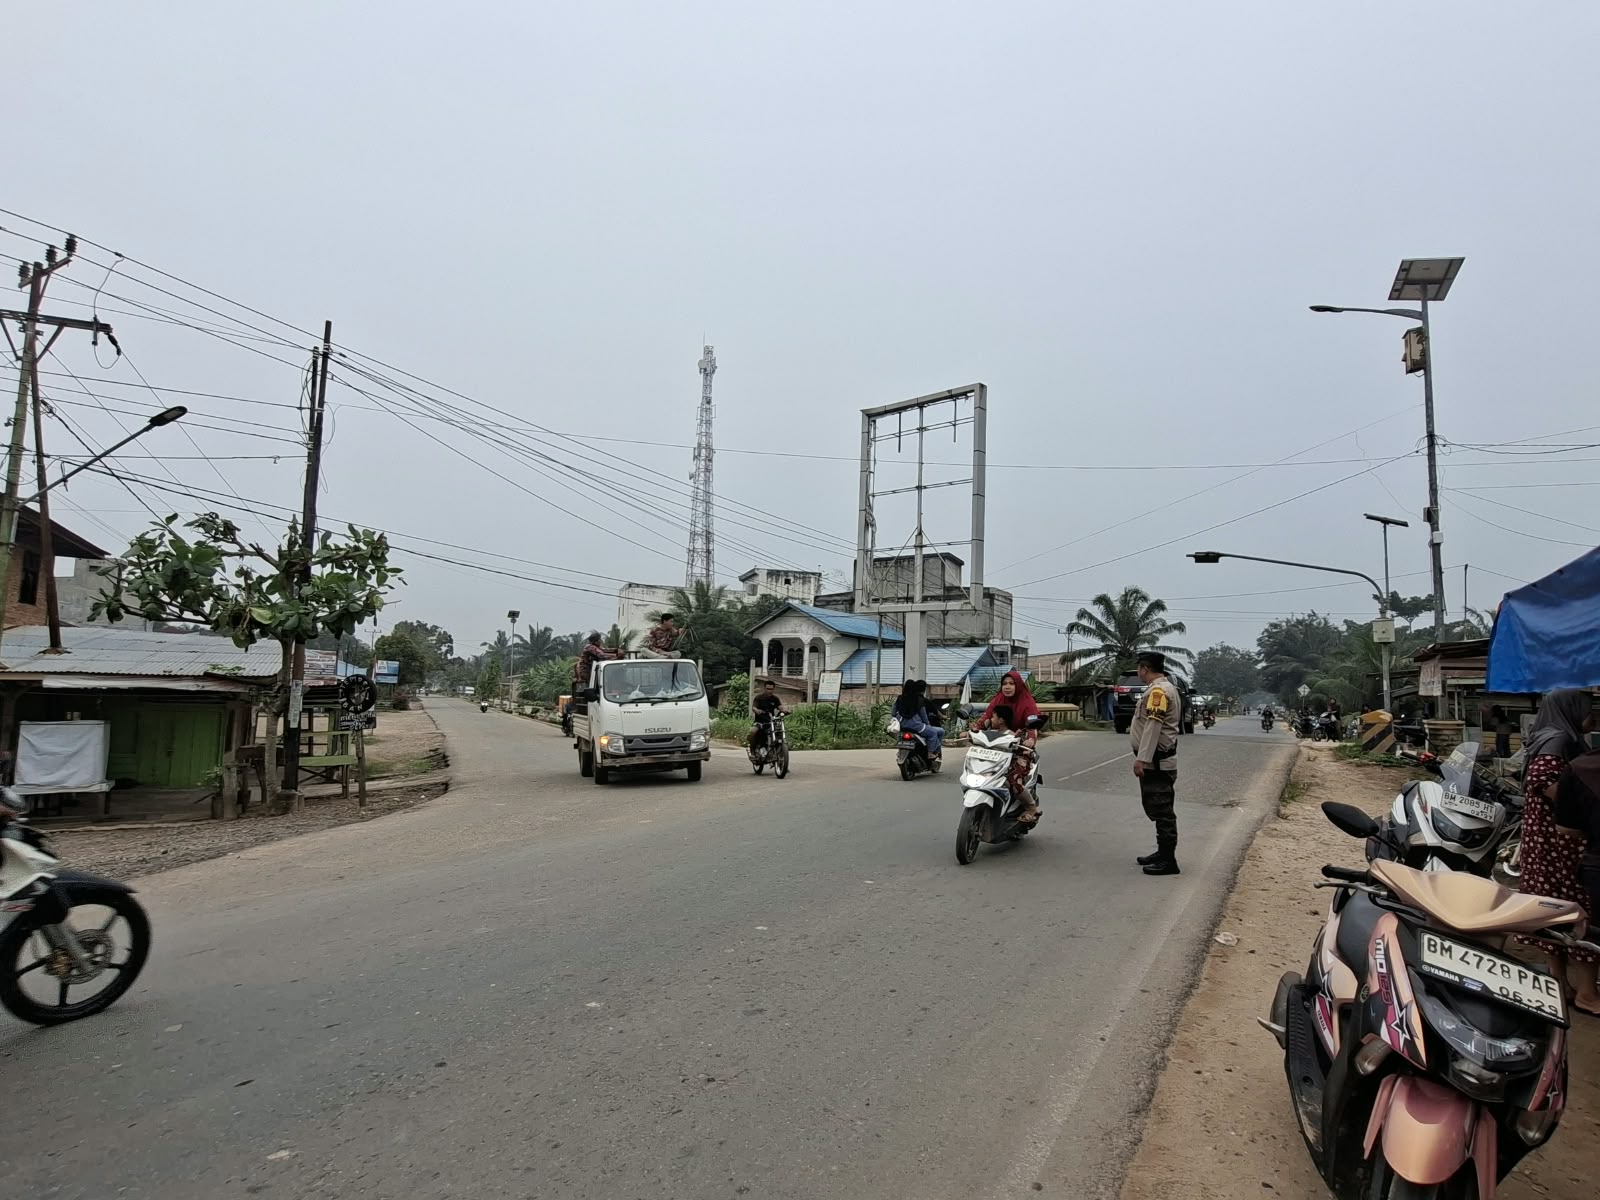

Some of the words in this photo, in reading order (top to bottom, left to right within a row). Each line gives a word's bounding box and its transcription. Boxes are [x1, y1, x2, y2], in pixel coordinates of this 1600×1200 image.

[1444, 792, 1456, 801] BM
[1459, 796, 1480, 809] 2085
[1483, 803, 1495, 814] HT
[1427, 937, 1453, 960] BM
[1459, 951, 1511, 980] 4728
[1518, 969, 1558, 999] PAE
[1430, 967, 1460, 982] YAMAHA
[1317, 1009, 1327, 1031] YAMAHA
